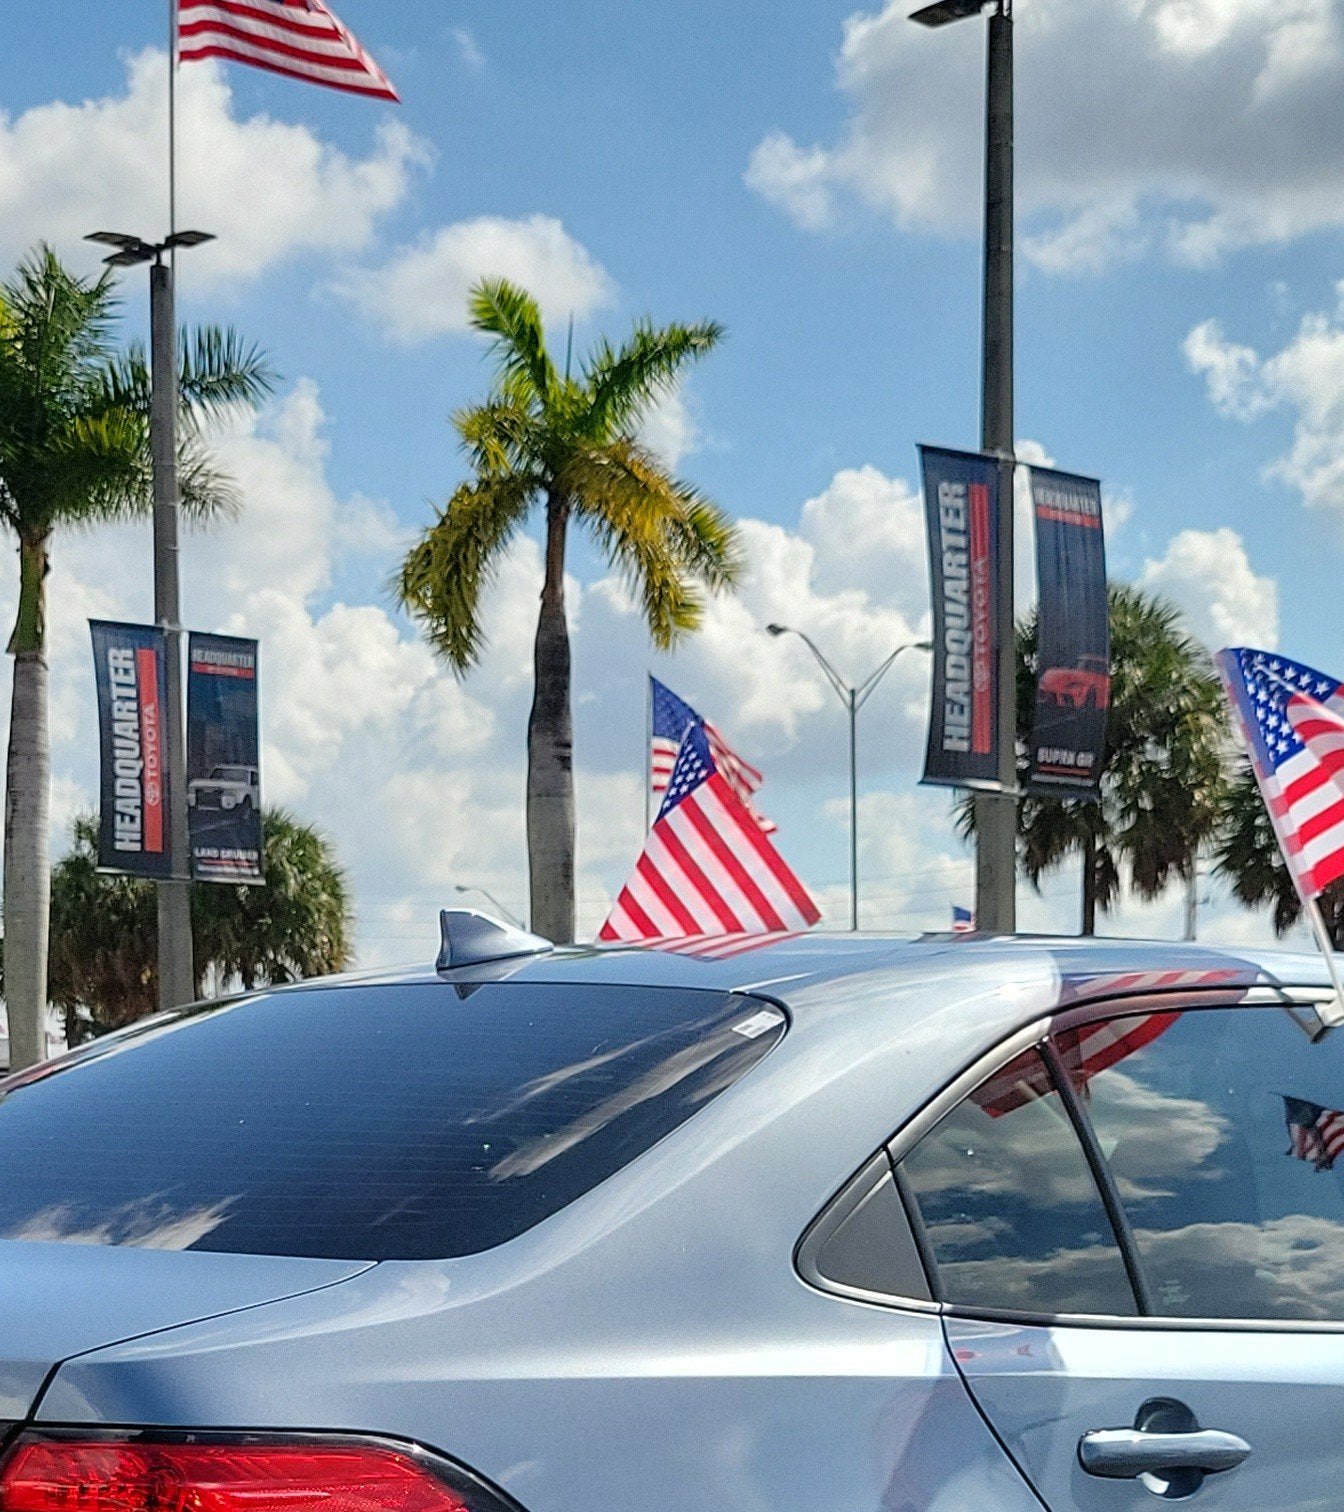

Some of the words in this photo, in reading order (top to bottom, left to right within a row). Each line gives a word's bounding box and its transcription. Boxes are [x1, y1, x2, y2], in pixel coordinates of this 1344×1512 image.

[938, 481, 971, 752] HEADQUARTER
[972, 558, 989, 652] TOYOTA
[108, 647, 143, 852] HEADQUARTER
[144, 701, 158, 777] TOYOTA
